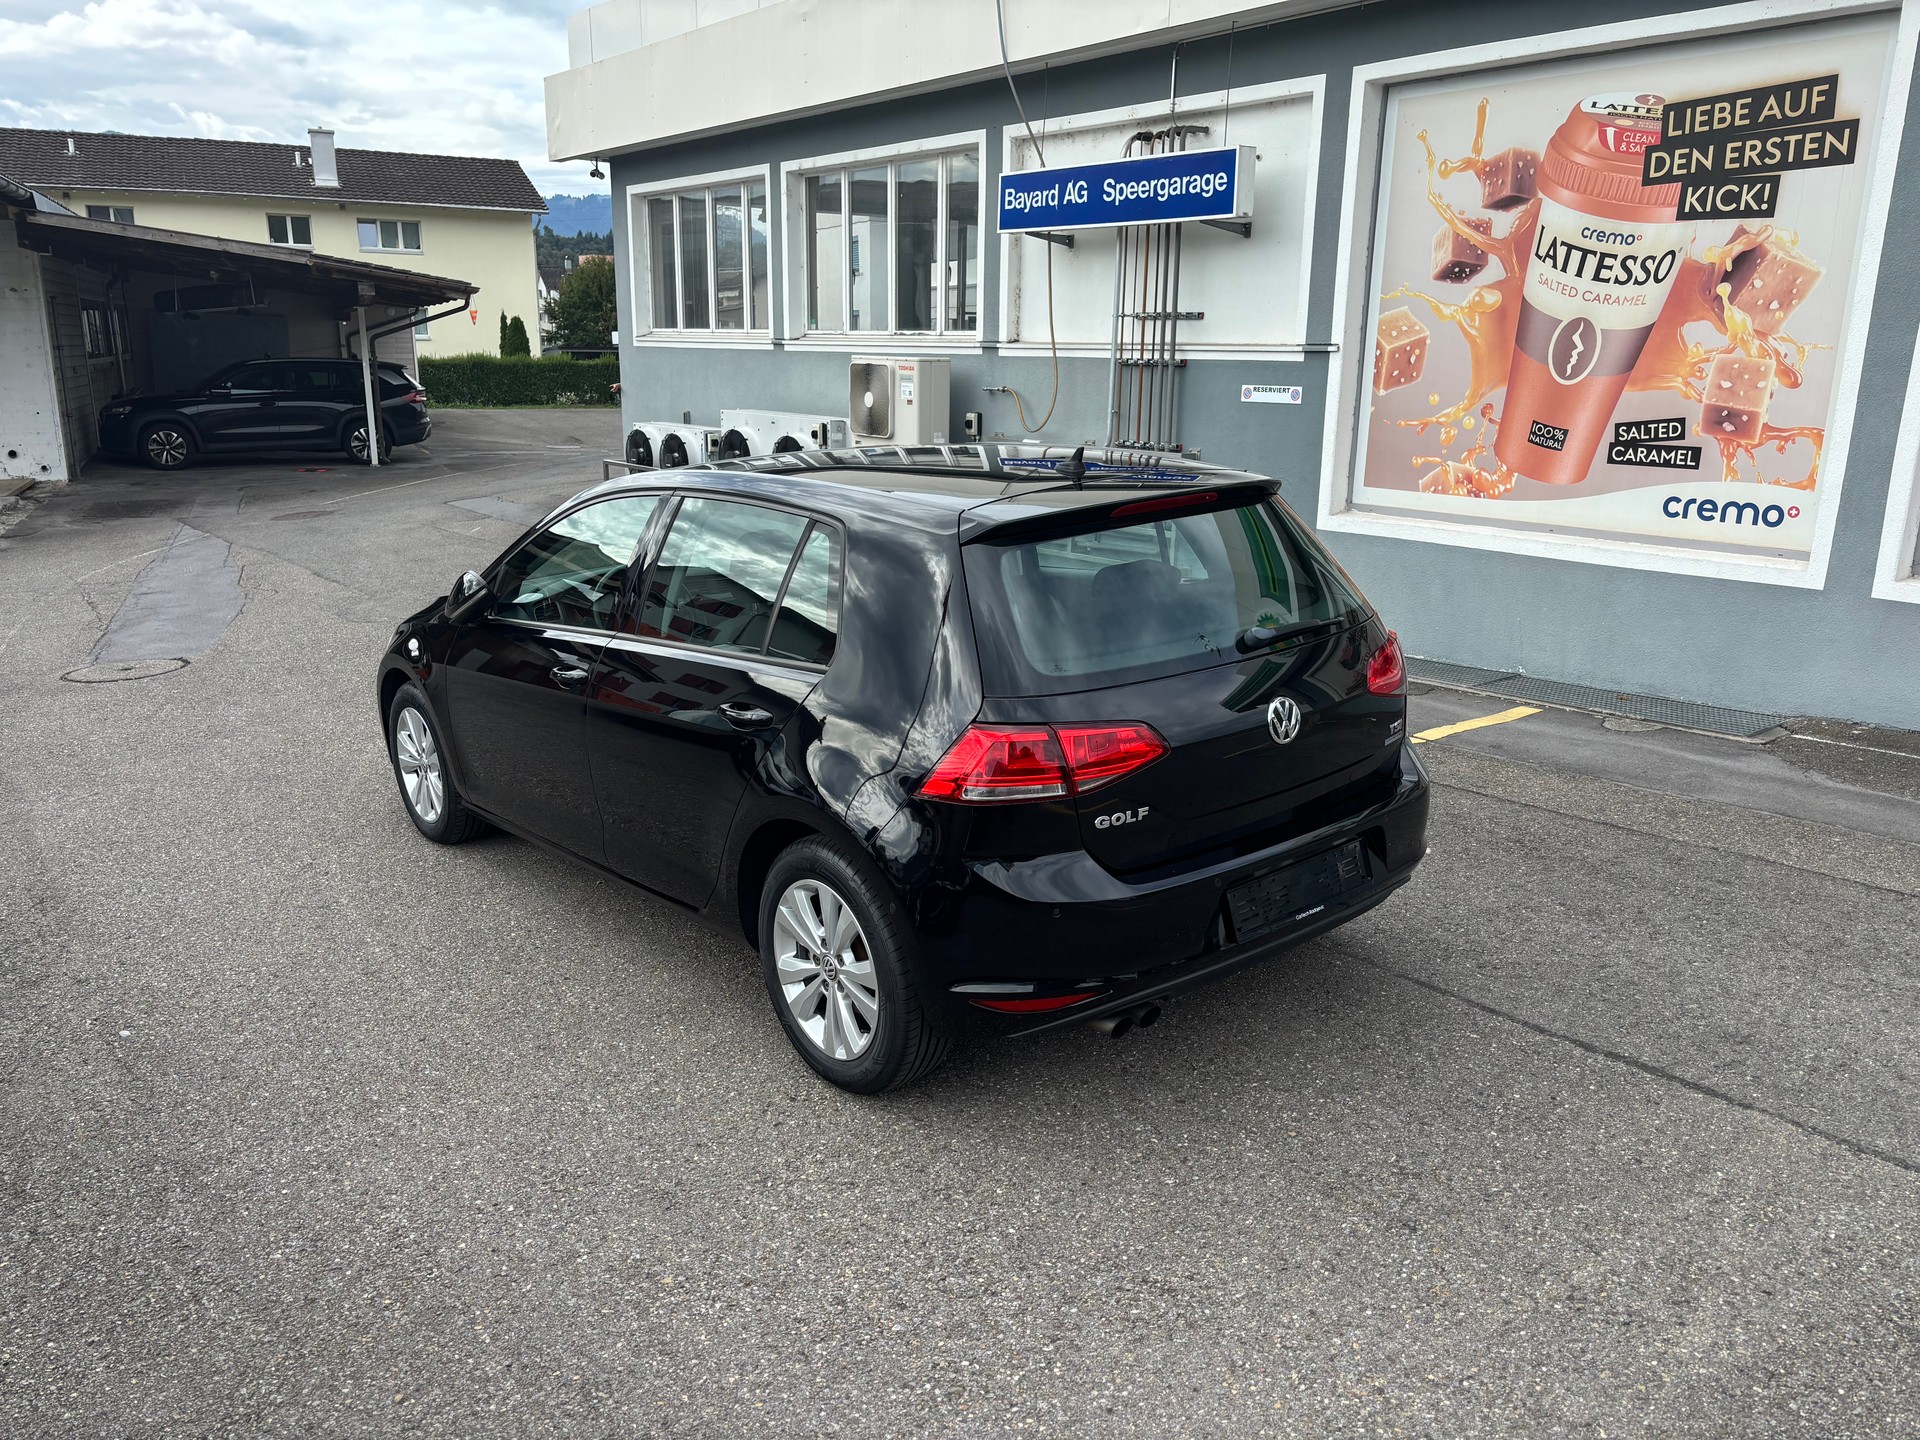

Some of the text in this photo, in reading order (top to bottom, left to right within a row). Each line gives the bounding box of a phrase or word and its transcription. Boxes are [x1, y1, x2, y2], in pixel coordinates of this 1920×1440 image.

[1590, 101, 1663, 118] LATTE
[1667, 84, 1830, 138] LIEBE AUF
[1619, 142, 1627, 151] &
[1622, 132, 1656, 144] CLEAN
[1649, 128, 1850, 179] DEN ERSTEN
[1004, 171, 1228, 213] Bayard AG Speergarage
[1684, 183, 1771, 213] KICK!
[1581, 226, 1636, 246] cremo
[1534, 224, 1677, 286] LATTESSO
[1538, 272, 1647, 307] SALTED CARAMEL
[1253, 386, 1291, 394] RESERVIERT
[1532, 422, 1565, 441] 100%
[1618, 422, 1682, 441] SALTED
[1529, 434, 1562, 450] NATURAL
[1612, 446, 1696, 466] CARAMEL
[1662, 496, 1785, 528] cremo
[1094, 806, 1149, 829] GOLF
